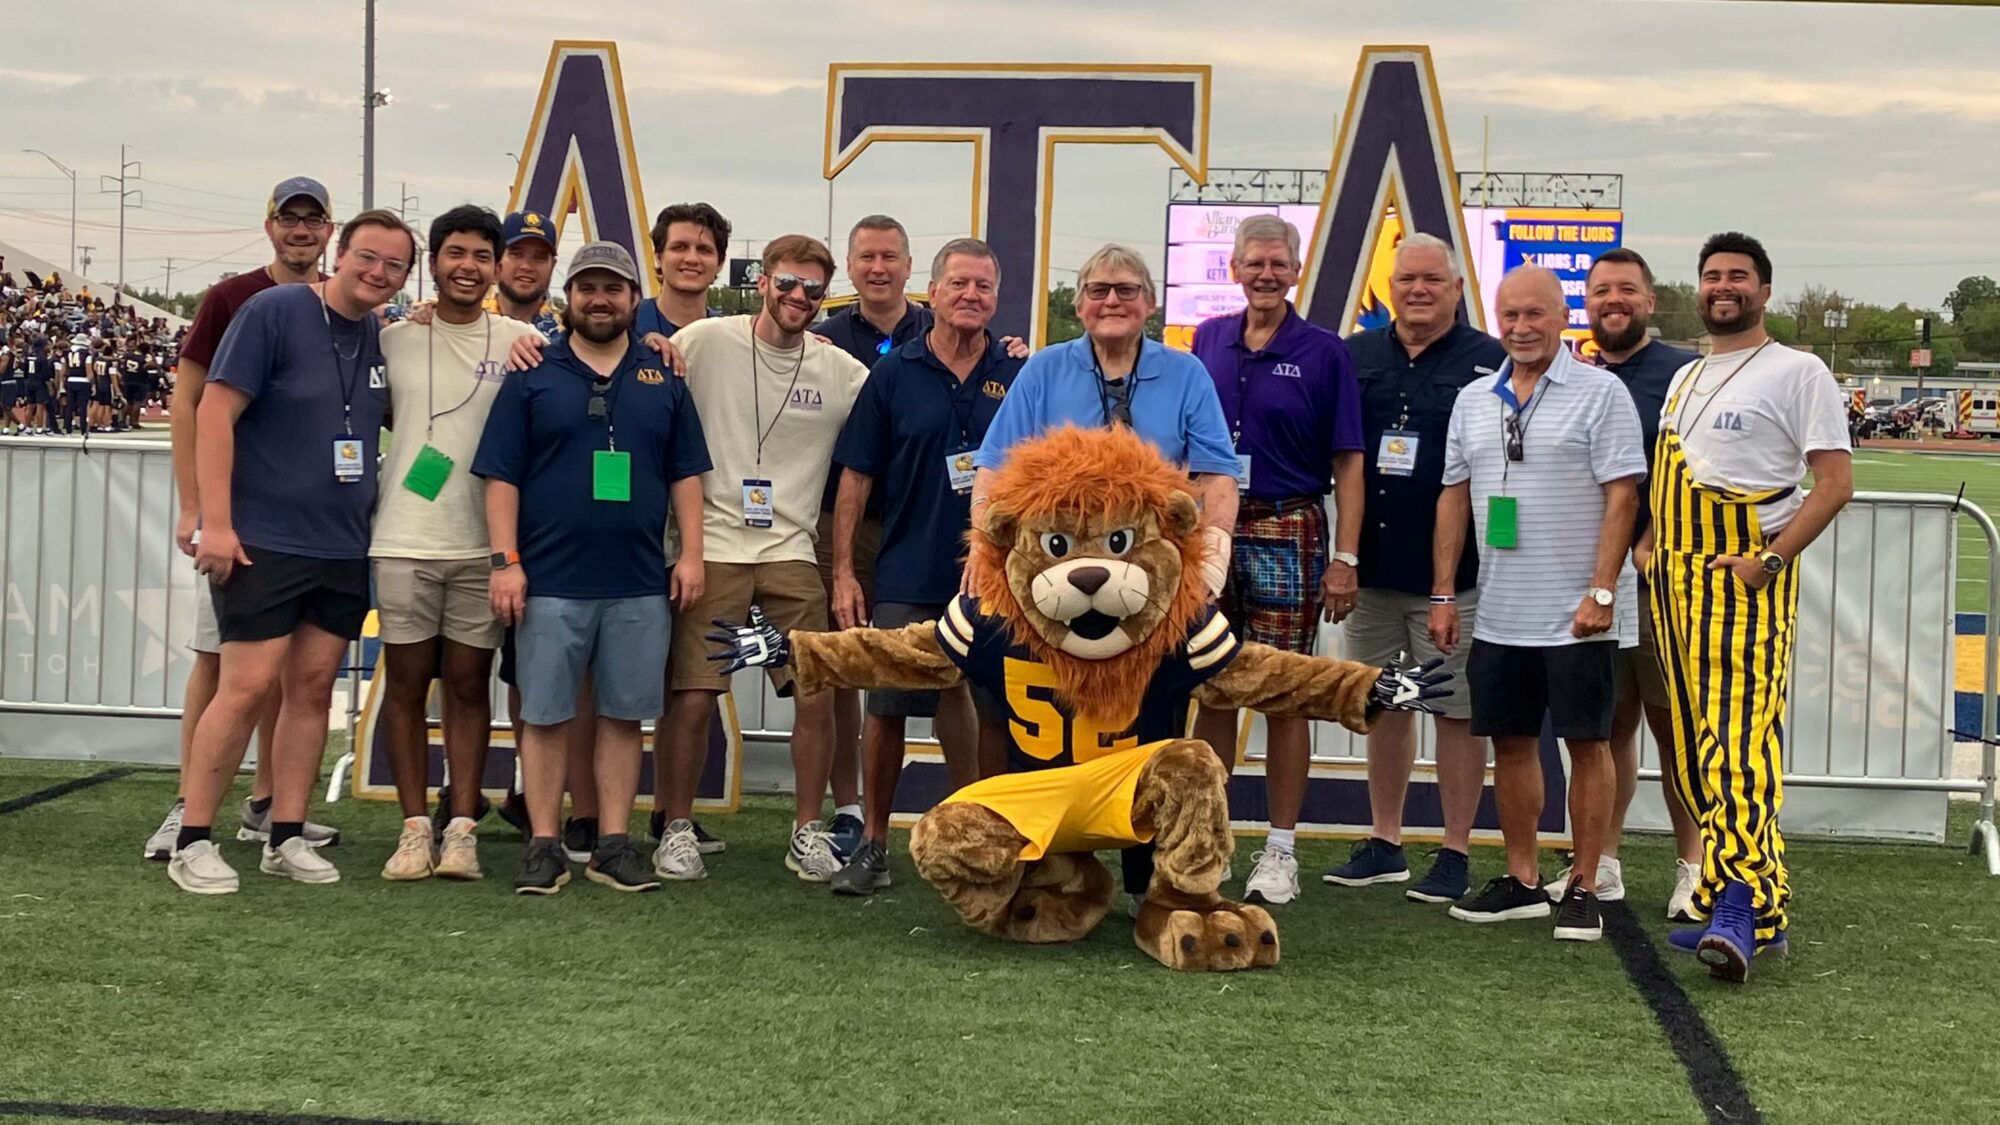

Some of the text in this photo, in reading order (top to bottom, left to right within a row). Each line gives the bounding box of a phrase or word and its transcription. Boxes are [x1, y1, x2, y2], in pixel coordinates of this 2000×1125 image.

[1509, 224, 1615, 242] FOLLOW THE LIONS
